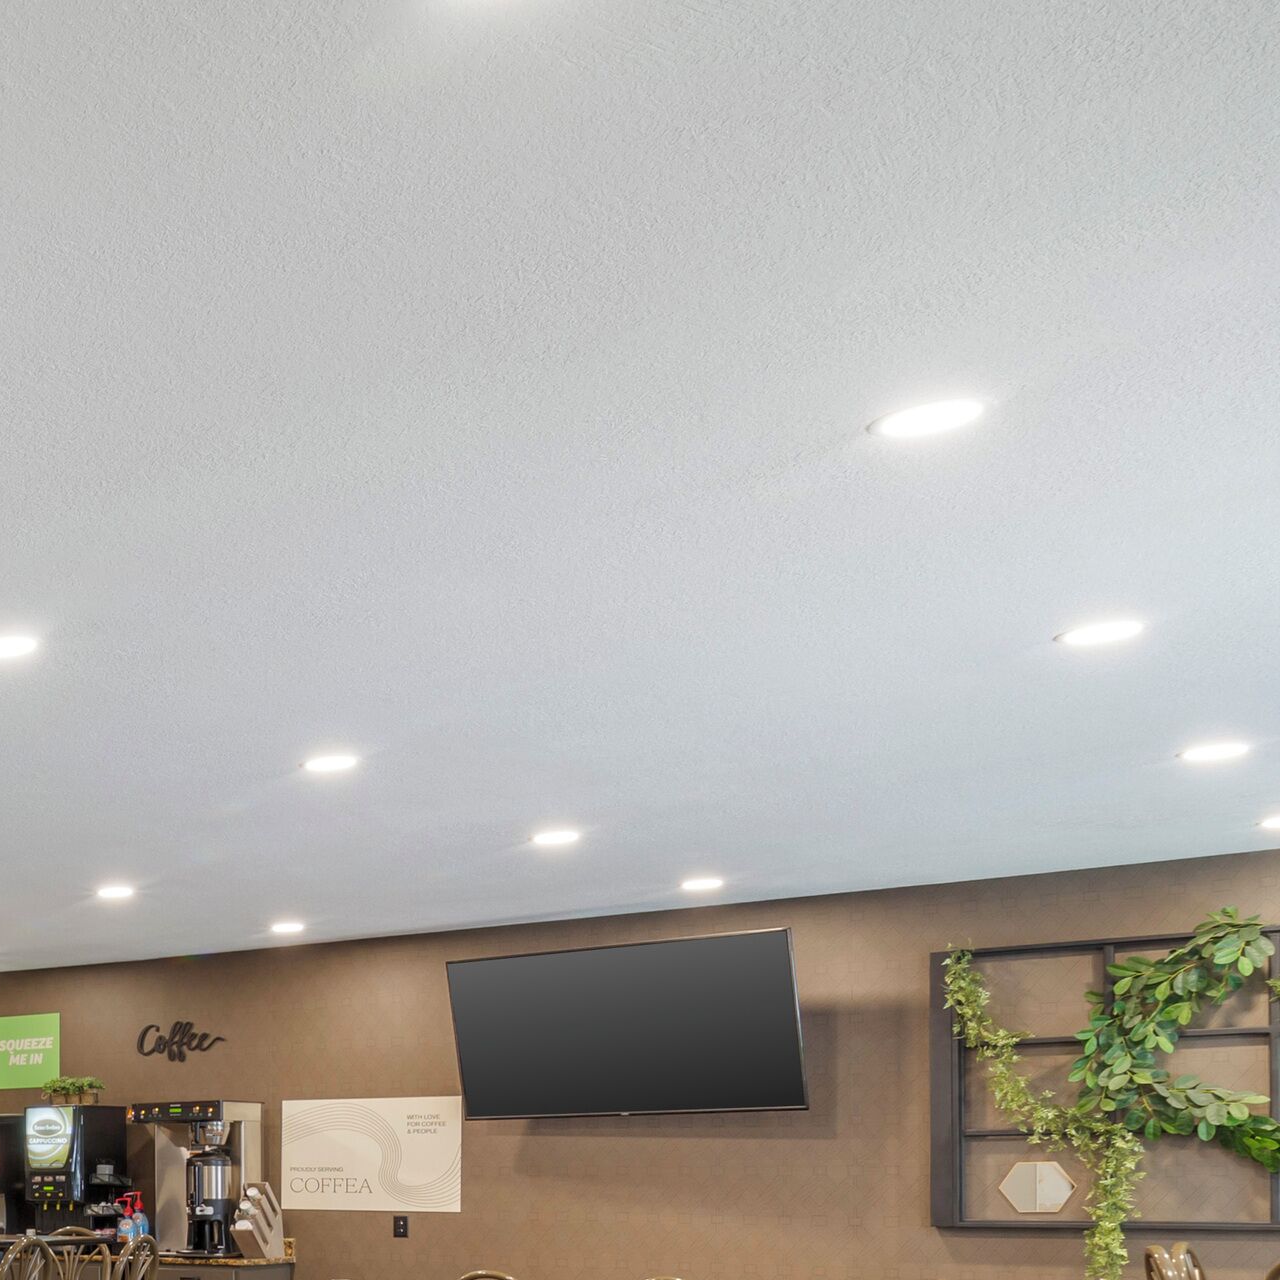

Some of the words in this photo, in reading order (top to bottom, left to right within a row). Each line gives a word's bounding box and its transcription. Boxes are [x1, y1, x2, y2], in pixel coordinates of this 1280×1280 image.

[0, 1036, 54, 1054] SQUEEZE
[137, 1021, 226, 1062] Coffee
[9, 1053, 27, 1066] ME
[29, 1052, 43, 1065] IN
[290, 1177, 373, 1194] COFFEA
